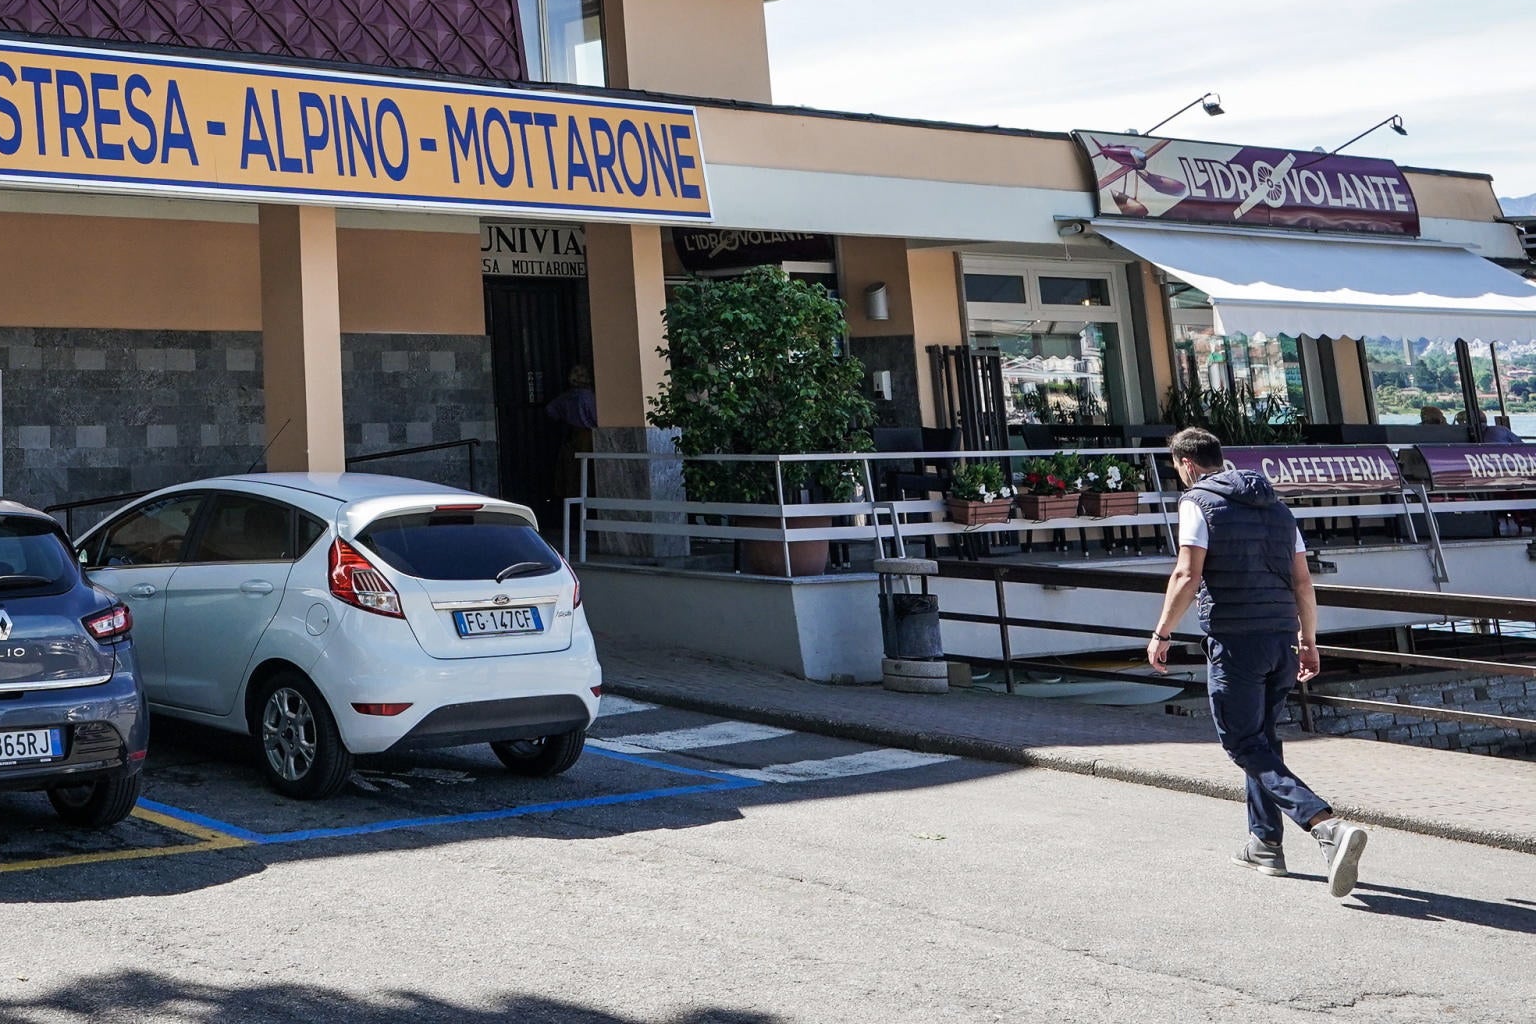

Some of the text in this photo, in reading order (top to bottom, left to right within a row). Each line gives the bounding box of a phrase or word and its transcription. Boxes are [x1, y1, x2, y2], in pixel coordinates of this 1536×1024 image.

[240, 86, 410, 182] ALPINO
[444, 106, 700, 199] MOTTARONE
[512, 259, 586, 276] MOTTARONE
[1261, 456, 1394, 484] CAFFETTERIA
